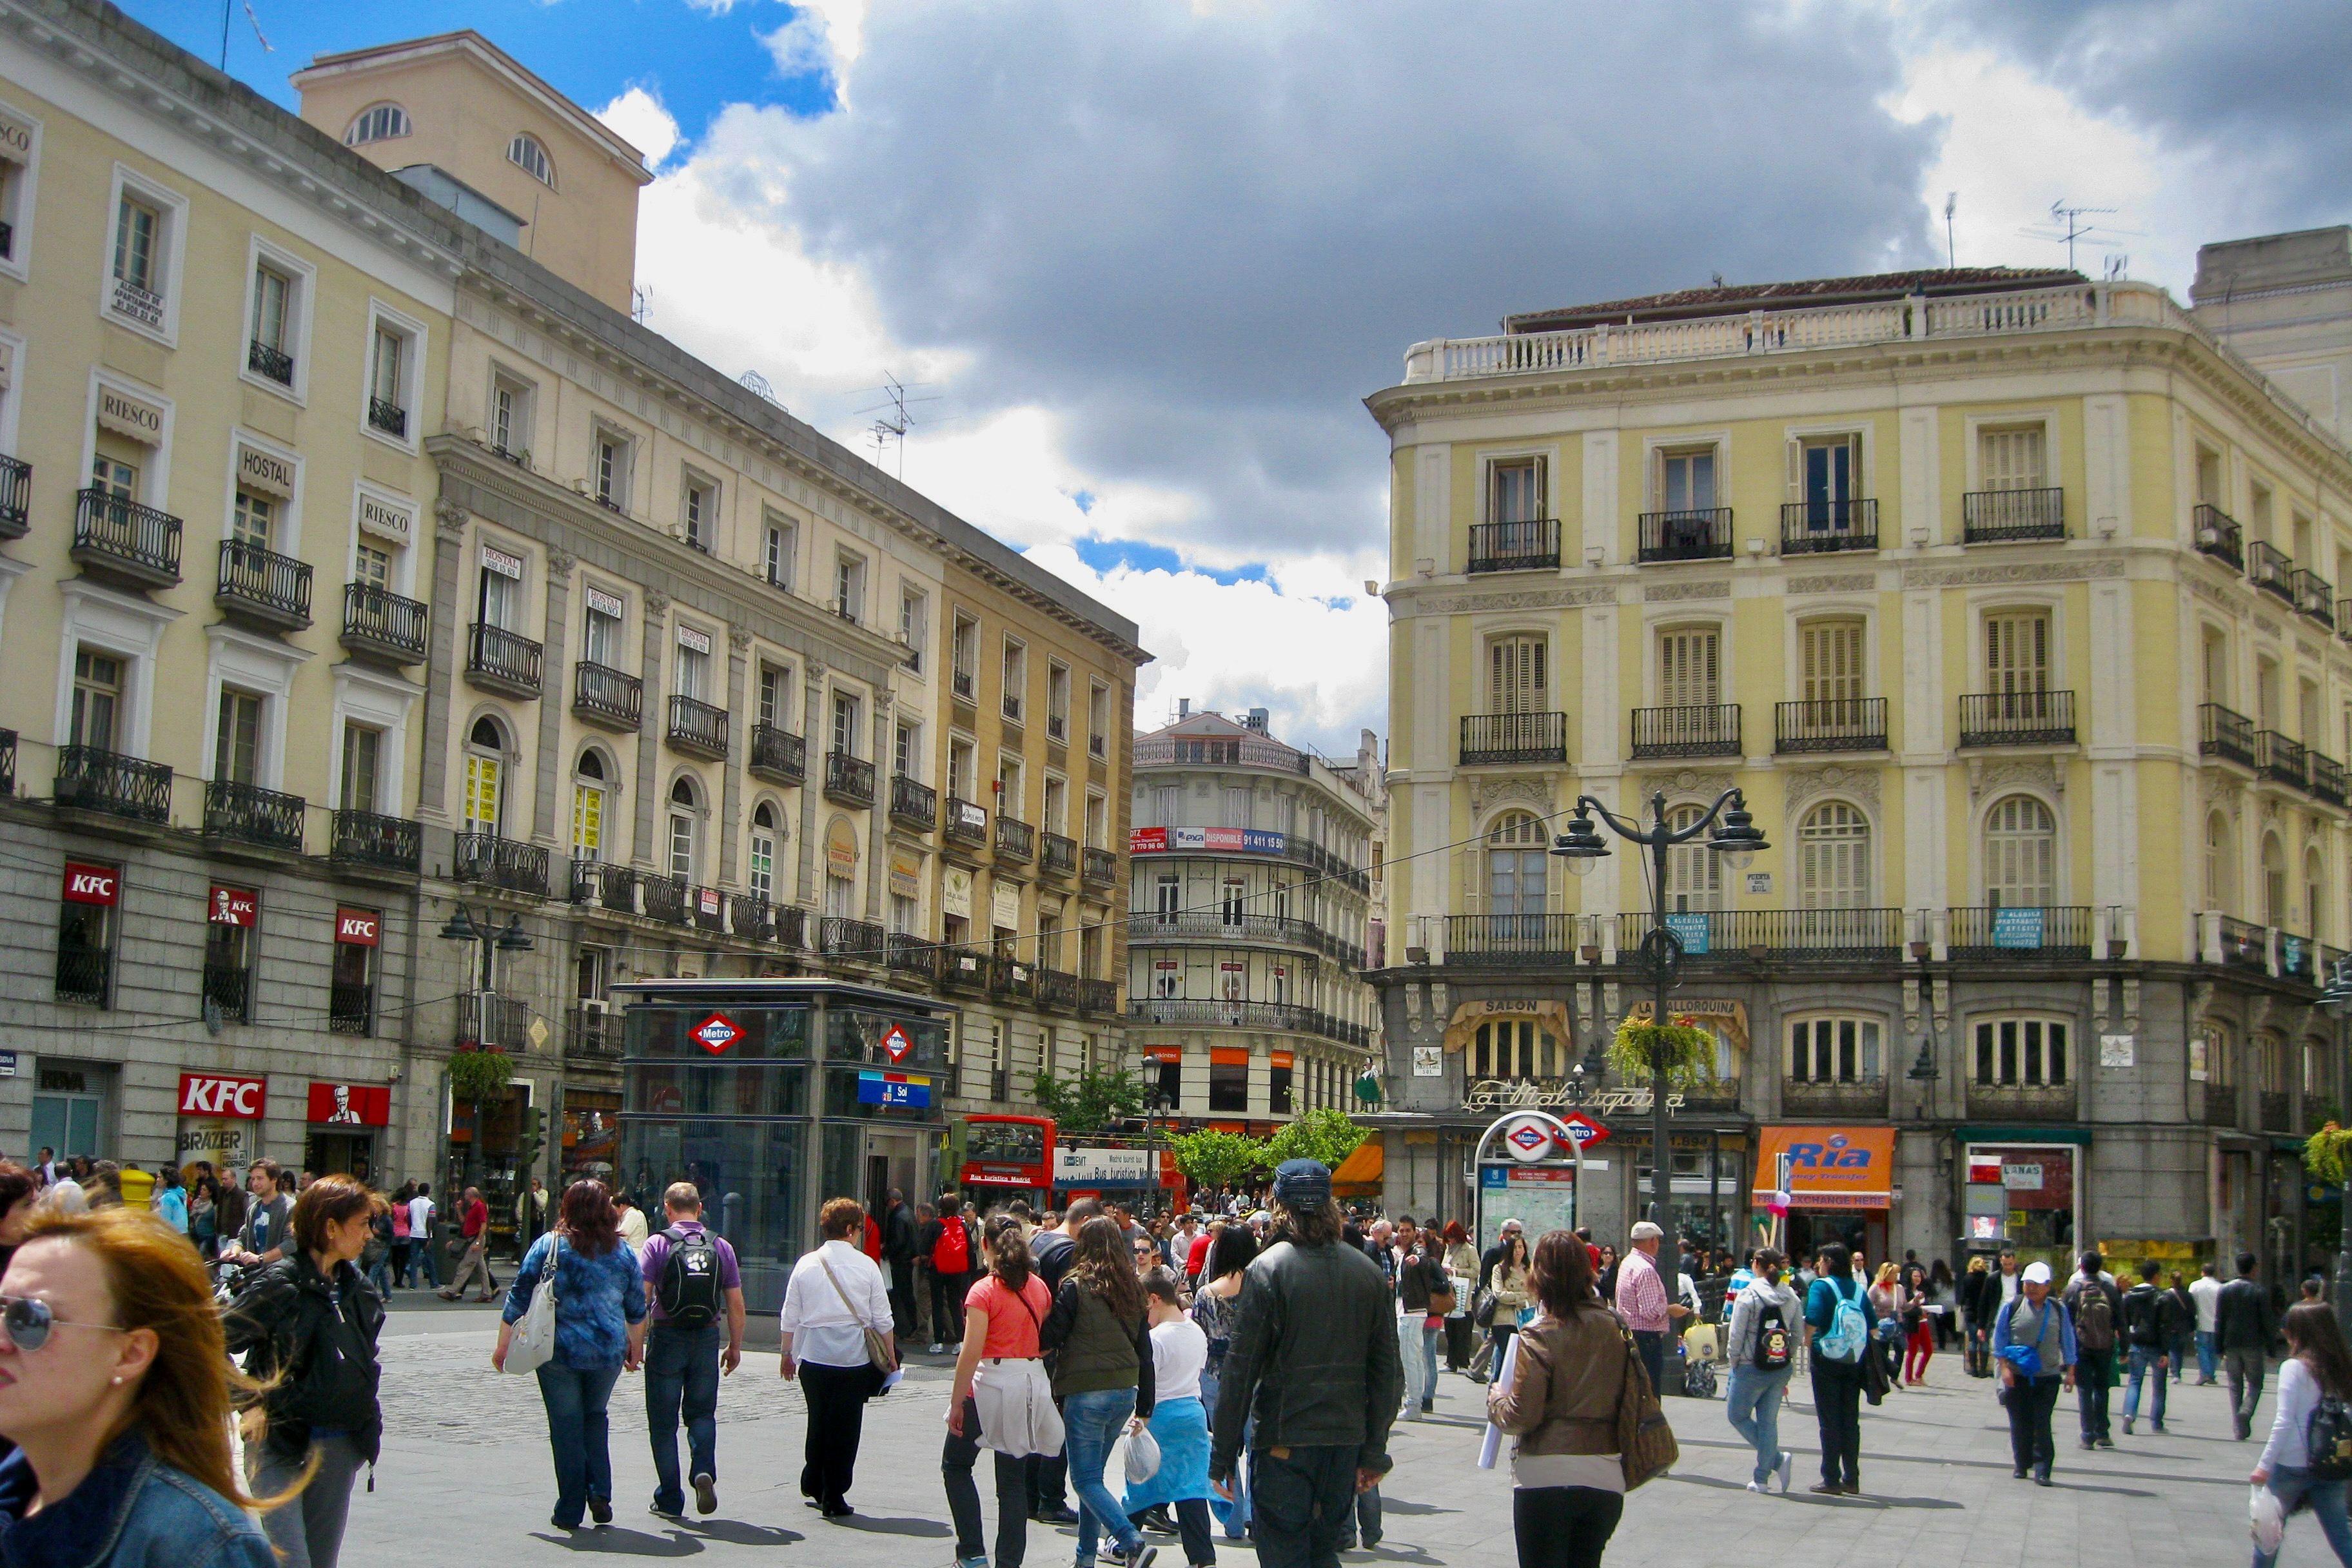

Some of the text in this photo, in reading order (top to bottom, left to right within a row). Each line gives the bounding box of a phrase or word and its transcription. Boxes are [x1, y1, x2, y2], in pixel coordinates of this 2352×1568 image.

[115, 289, 163, 318] APARTAMENTOS
[105, 395, 159, 431] RIESCO
[244, 451, 290, 486] HOSTAL
[366, 502, 408, 533] RIESCO
[485, 547, 518, 569] HOSTAL
[486, 558, 498, 571] 532
[500, 564, 507, 574] 15
[591, 589, 620, 609] HOSTAL
[591, 600, 618, 616] RUANO
[681, 627, 708, 645] HOSTAL
[1130, 829, 1141, 838] DTZ
[1206, 833, 1284, 850] DISPONIBLE 91 411 15 50
[71, 874, 113, 896] KFC
[232, 900, 253, 913] KFC
[342, 918, 375, 937] KFC
[1638, 1000, 1736, 1014] LA ALLORQUINA
[702, 1028, 730, 1039] Metro
[889, 1037, 905, 1048] Metro
[182, 1077, 259, 1115] KFC
[897, 1085, 908, 1097] Sol
[179, 1130, 242, 1151] BRAZER
[1787, 1135, 1872, 1168] Ria
[222, 1160, 246, 1169] HORNO
[1075, 1156, 1086, 1166] EMT
[1095, 1166, 1107, 1180] Bus
[2004, 1166, 2041, 1174] LANAS
[1792, 1195, 1850, 1205] EXCHANGE
[1854, 1197, 1885, 1206] HERE
